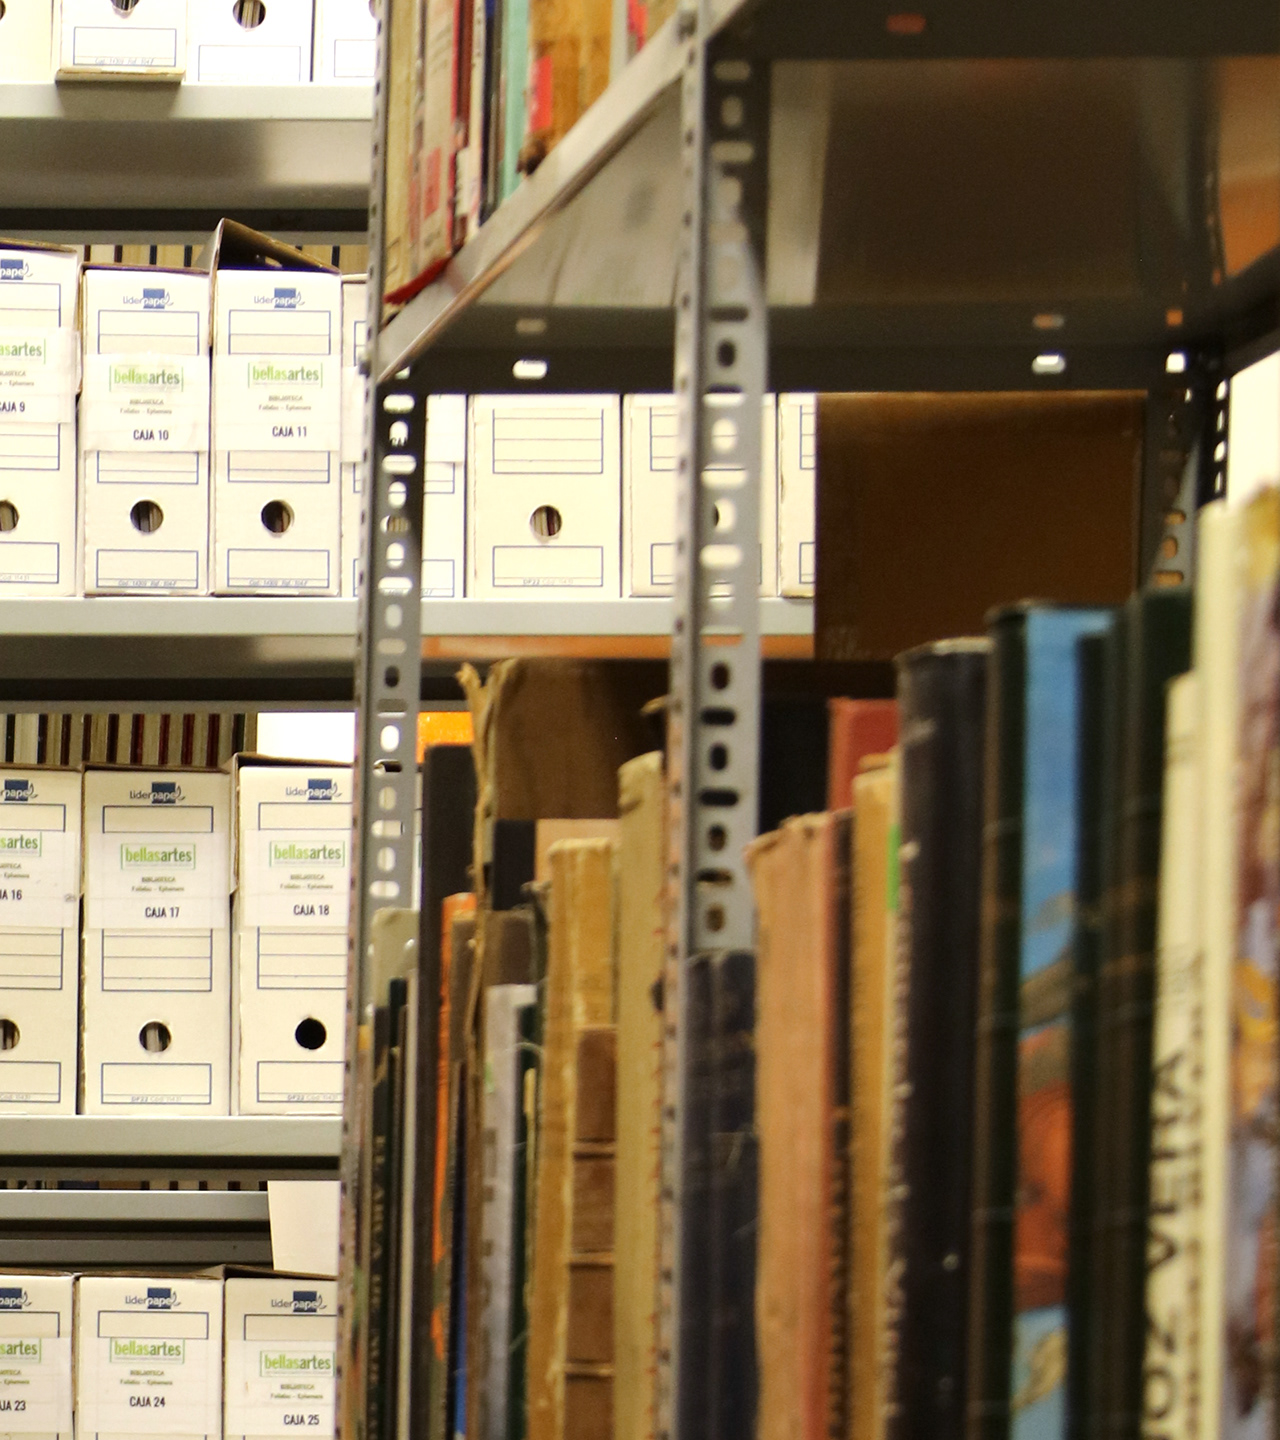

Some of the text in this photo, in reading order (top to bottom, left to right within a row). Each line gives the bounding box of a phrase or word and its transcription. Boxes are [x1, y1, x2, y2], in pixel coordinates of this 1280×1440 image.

[114, 368, 181, 386] bellasartes
[253, 365, 319, 382] bellasartes
[19, 401, 26, 413] 9
[133, 430, 169, 441] CAJA 10
[272, 426, 308, 438] CAJA 11
[125, 846, 192, 864] bellasartes
[274, 844, 341, 861] bellasartes
[11, 889, 22, 900] 16
[145, 907, 180, 918] CAJA 17
[294, 905, 329, 916] CAJA 18
[114, 1340, 181, 1358] bellasartes
[264, 1354, 331, 1371] bellasartes
[15, 1400, 26, 1411] 23
[130, 1396, 165, 1408] CAJA 24
[284, 1415, 319, 1425] CAJA 25
